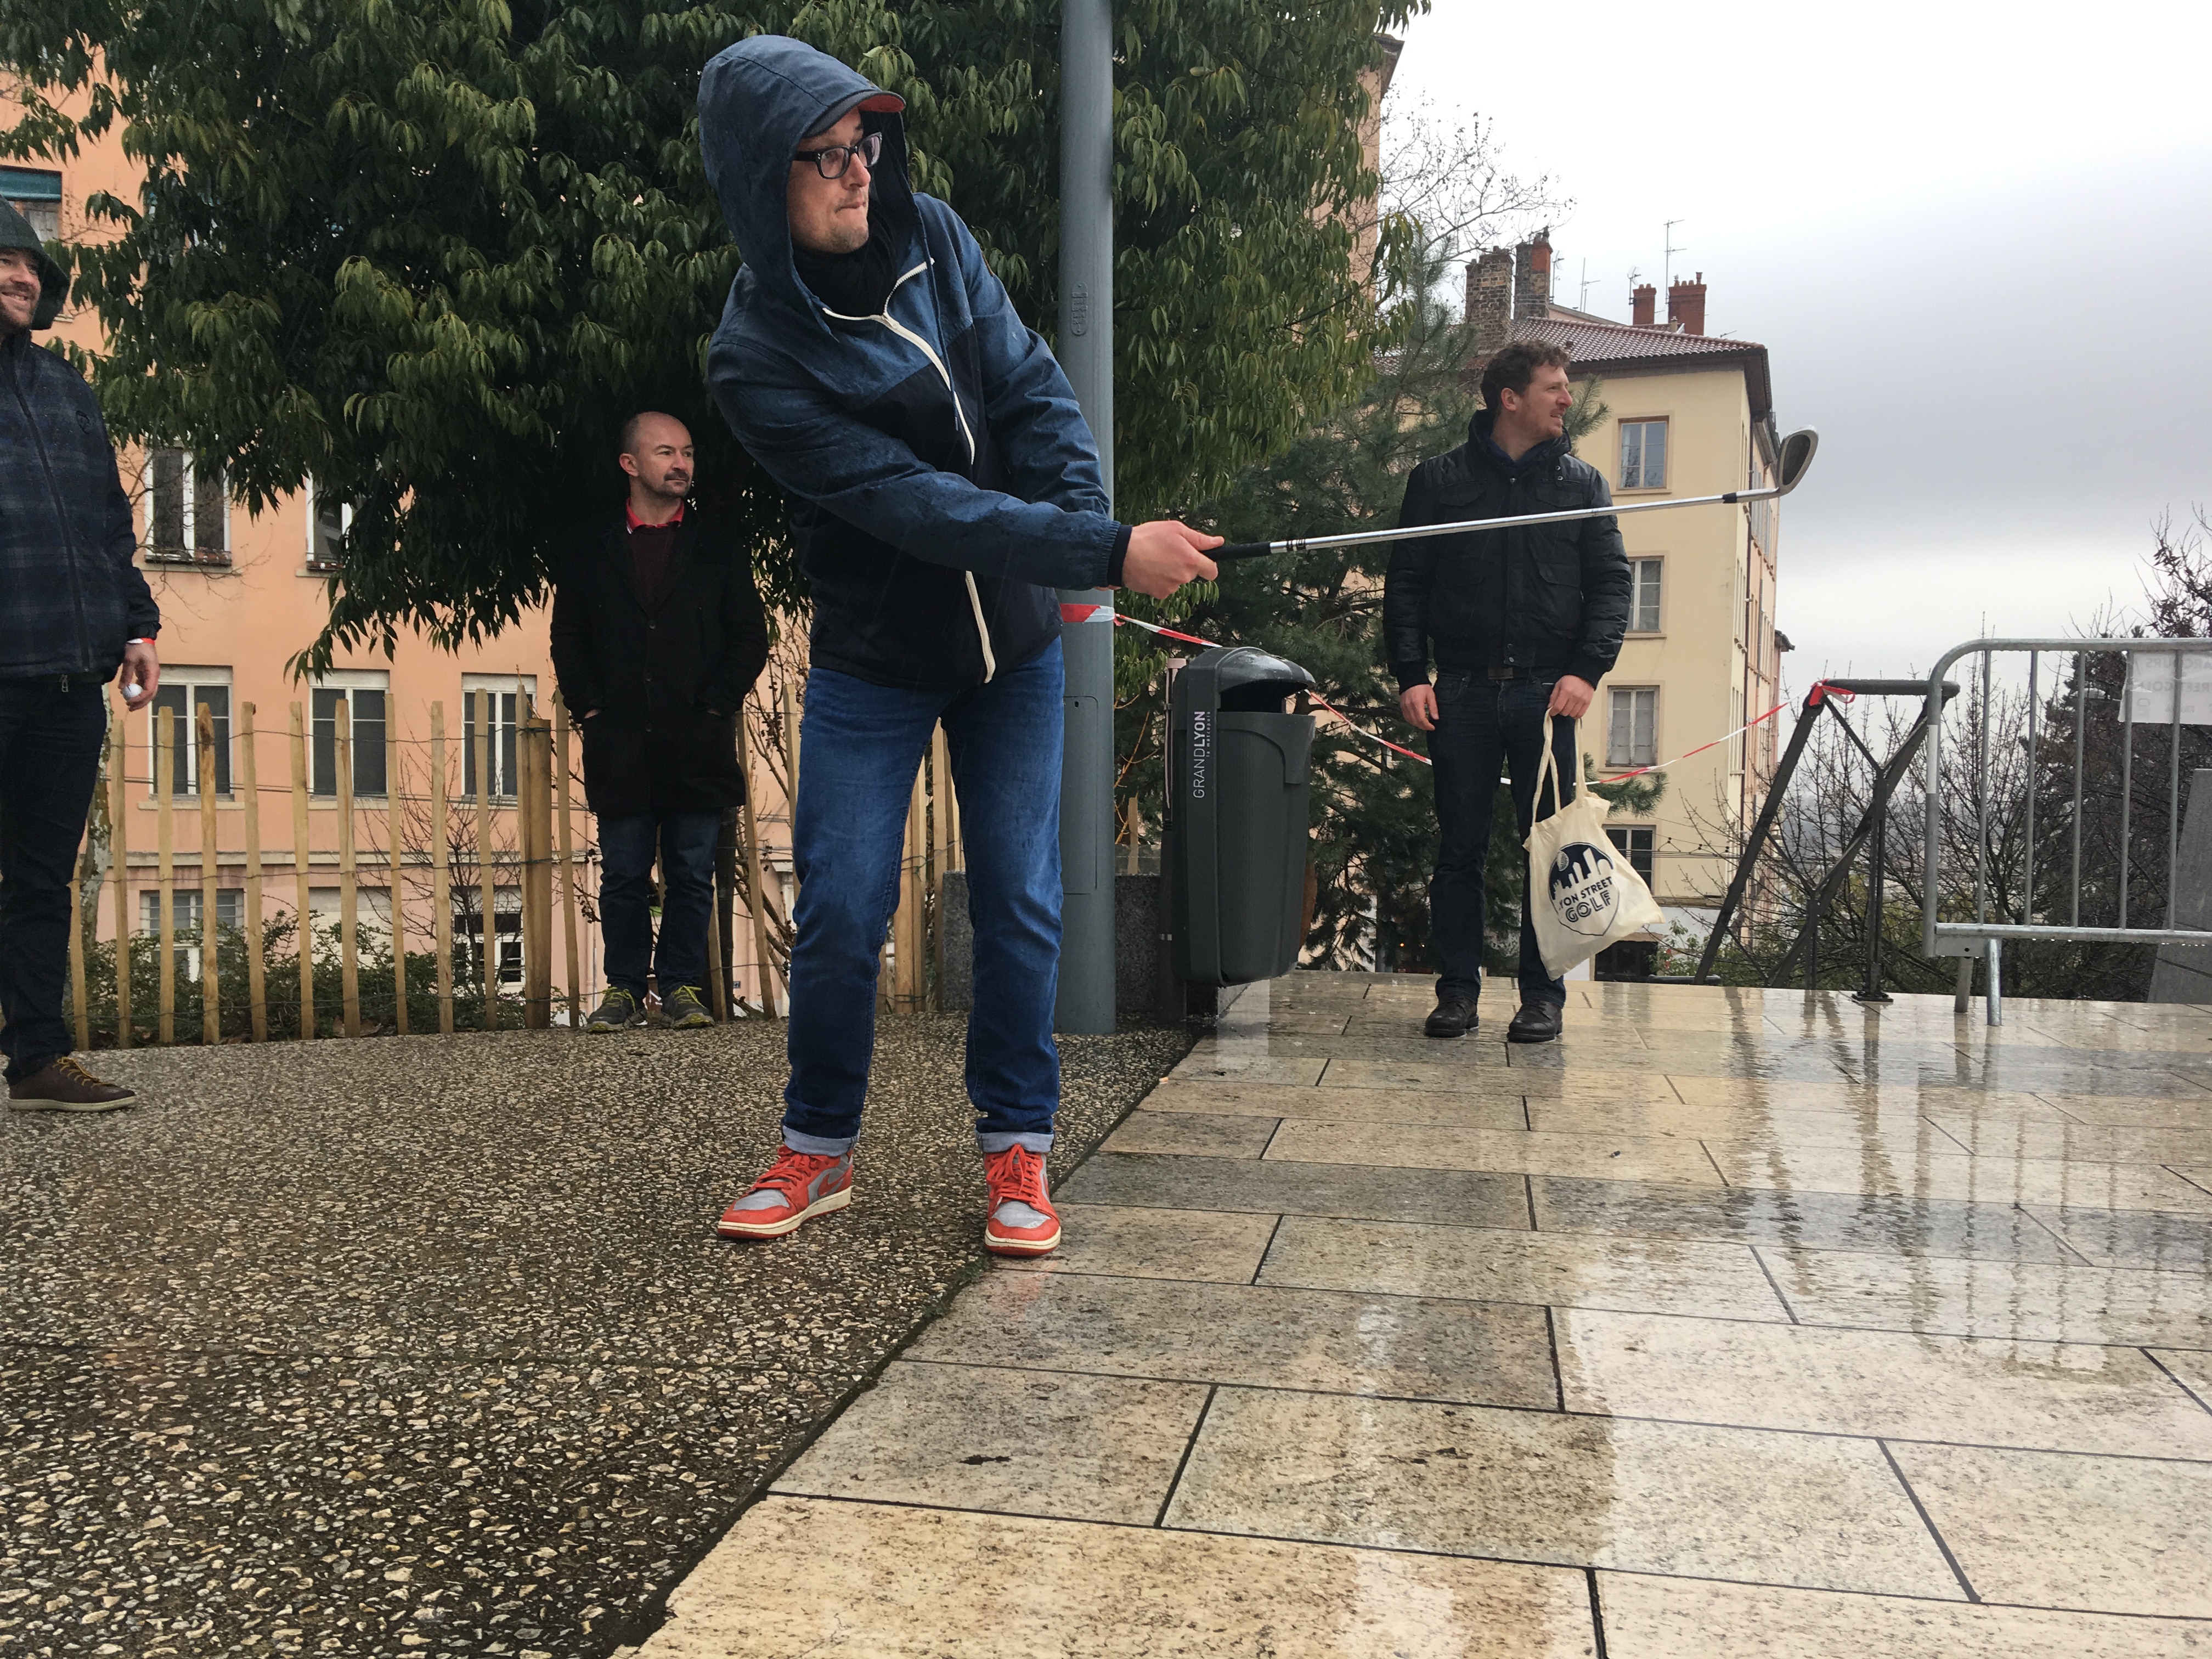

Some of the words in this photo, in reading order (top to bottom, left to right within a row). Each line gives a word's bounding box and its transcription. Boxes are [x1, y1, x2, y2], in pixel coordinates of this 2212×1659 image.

[1559, 893, 1579, 911] YON
[1581, 876, 1612, 899] STREET
[1565, 890, 1611, 923] GOLF
